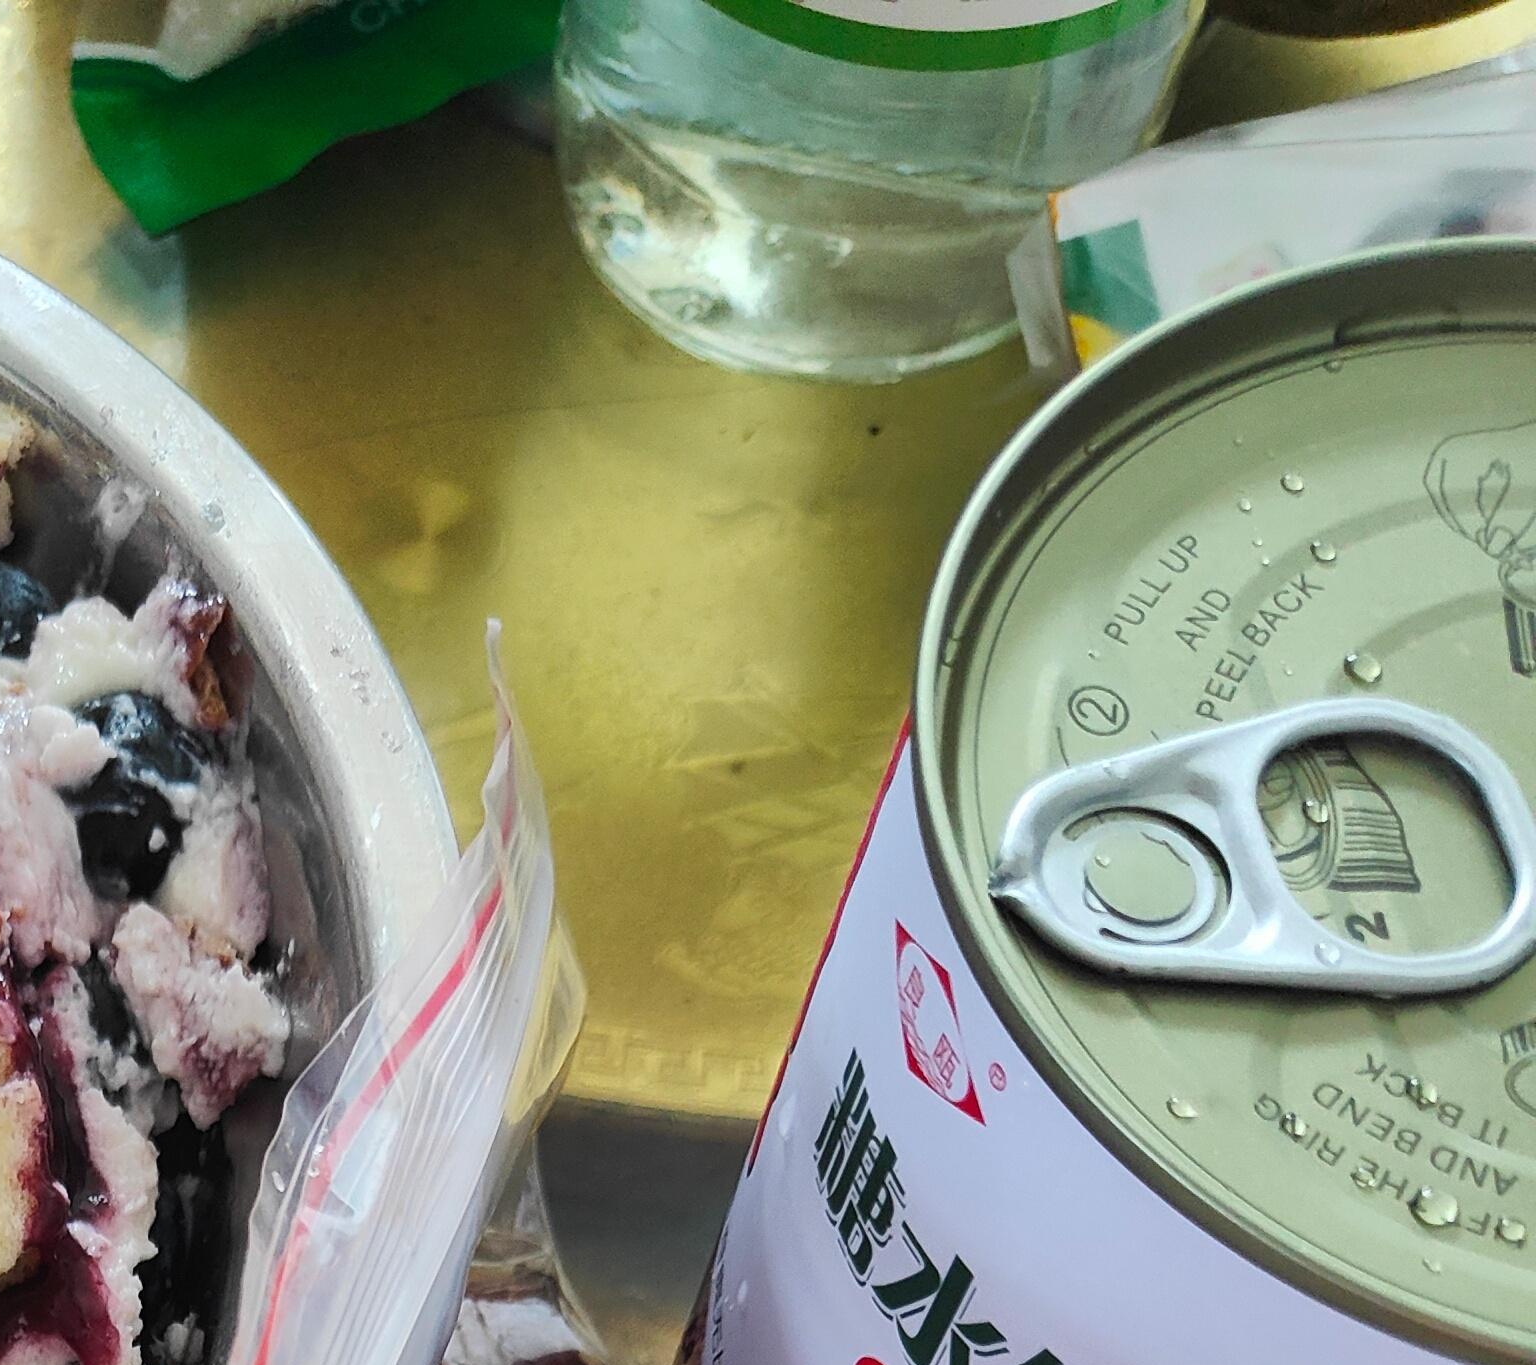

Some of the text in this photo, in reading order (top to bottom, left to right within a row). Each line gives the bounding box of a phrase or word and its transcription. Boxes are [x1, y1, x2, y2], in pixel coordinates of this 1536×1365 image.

[1103, 533, 1201, 647] PULL UP
[1175, 586, 1232, 654] AND
[1195, 572, 1326, 722] PEEL BACK
[1312, 1083, 1519, 1197] AND BEND
[1469, 1119, 1509, 1150] IT
